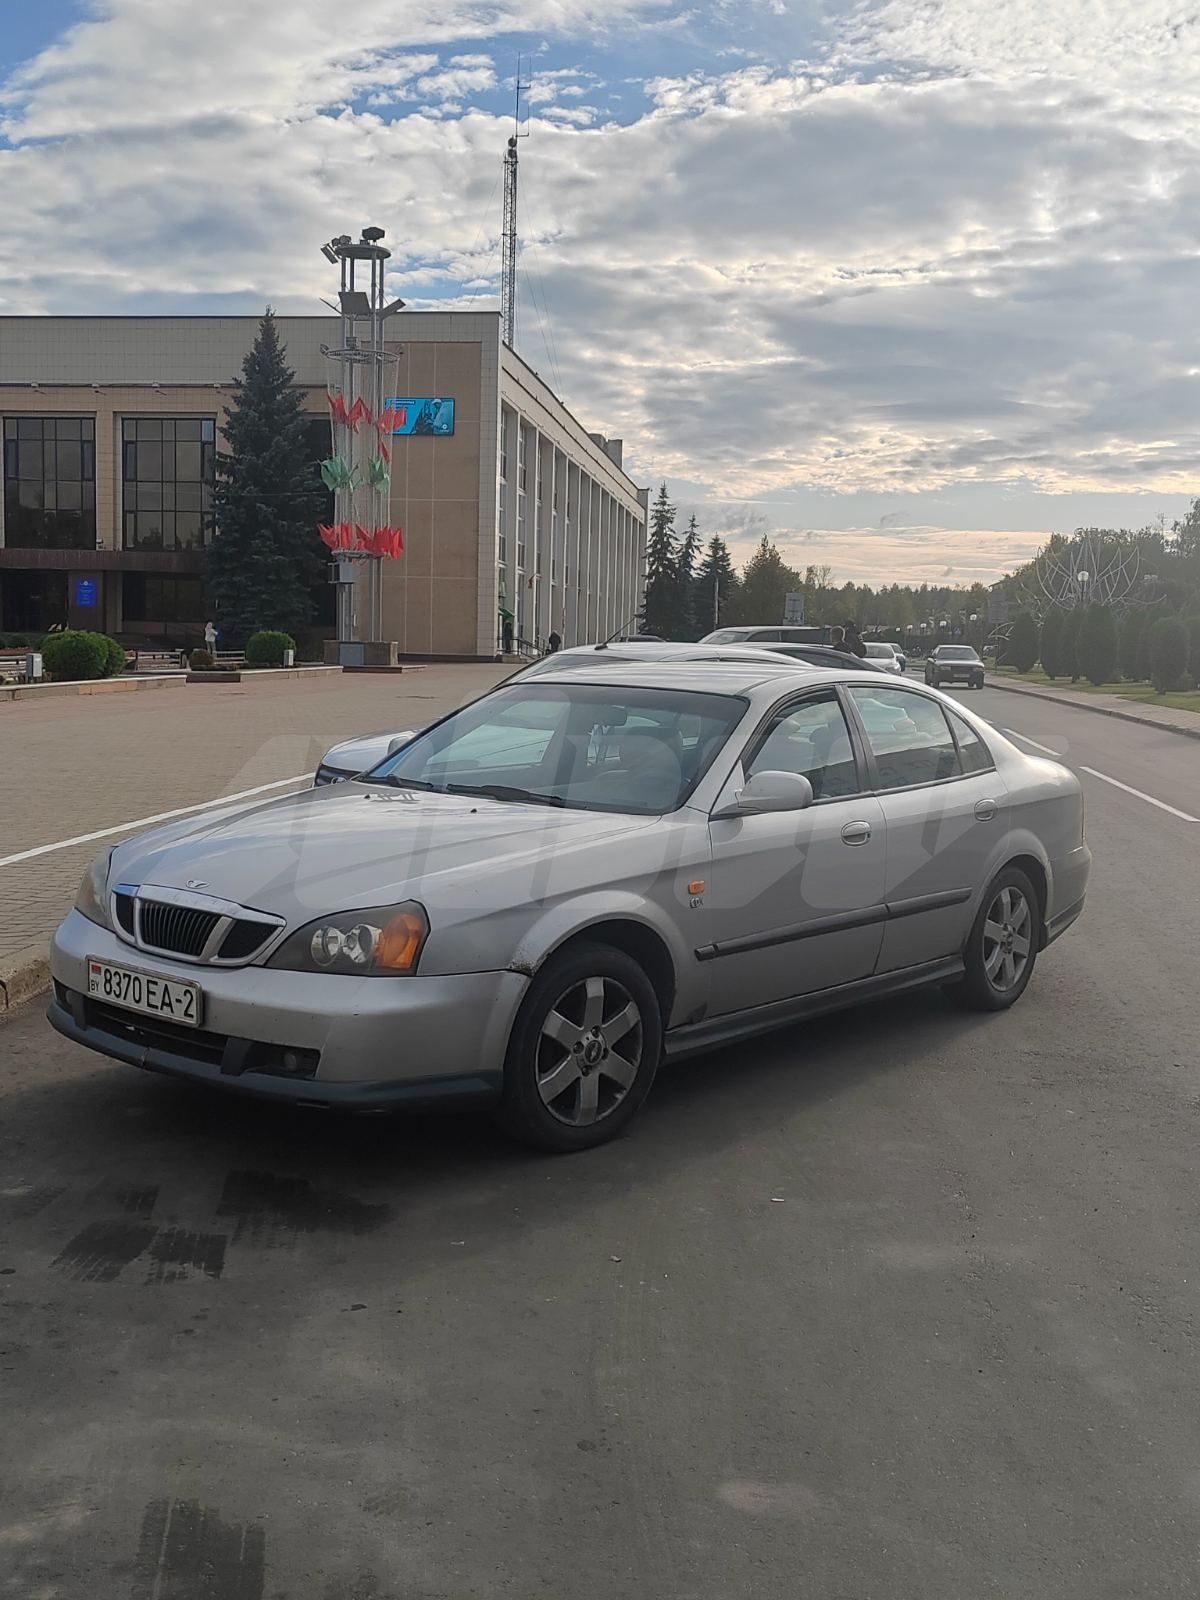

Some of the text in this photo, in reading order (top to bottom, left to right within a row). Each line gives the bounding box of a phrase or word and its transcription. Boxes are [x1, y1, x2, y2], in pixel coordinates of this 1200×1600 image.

[91, 980, 99, 992] BY
[103, 968, 194, 1018] 8370 EA-2
